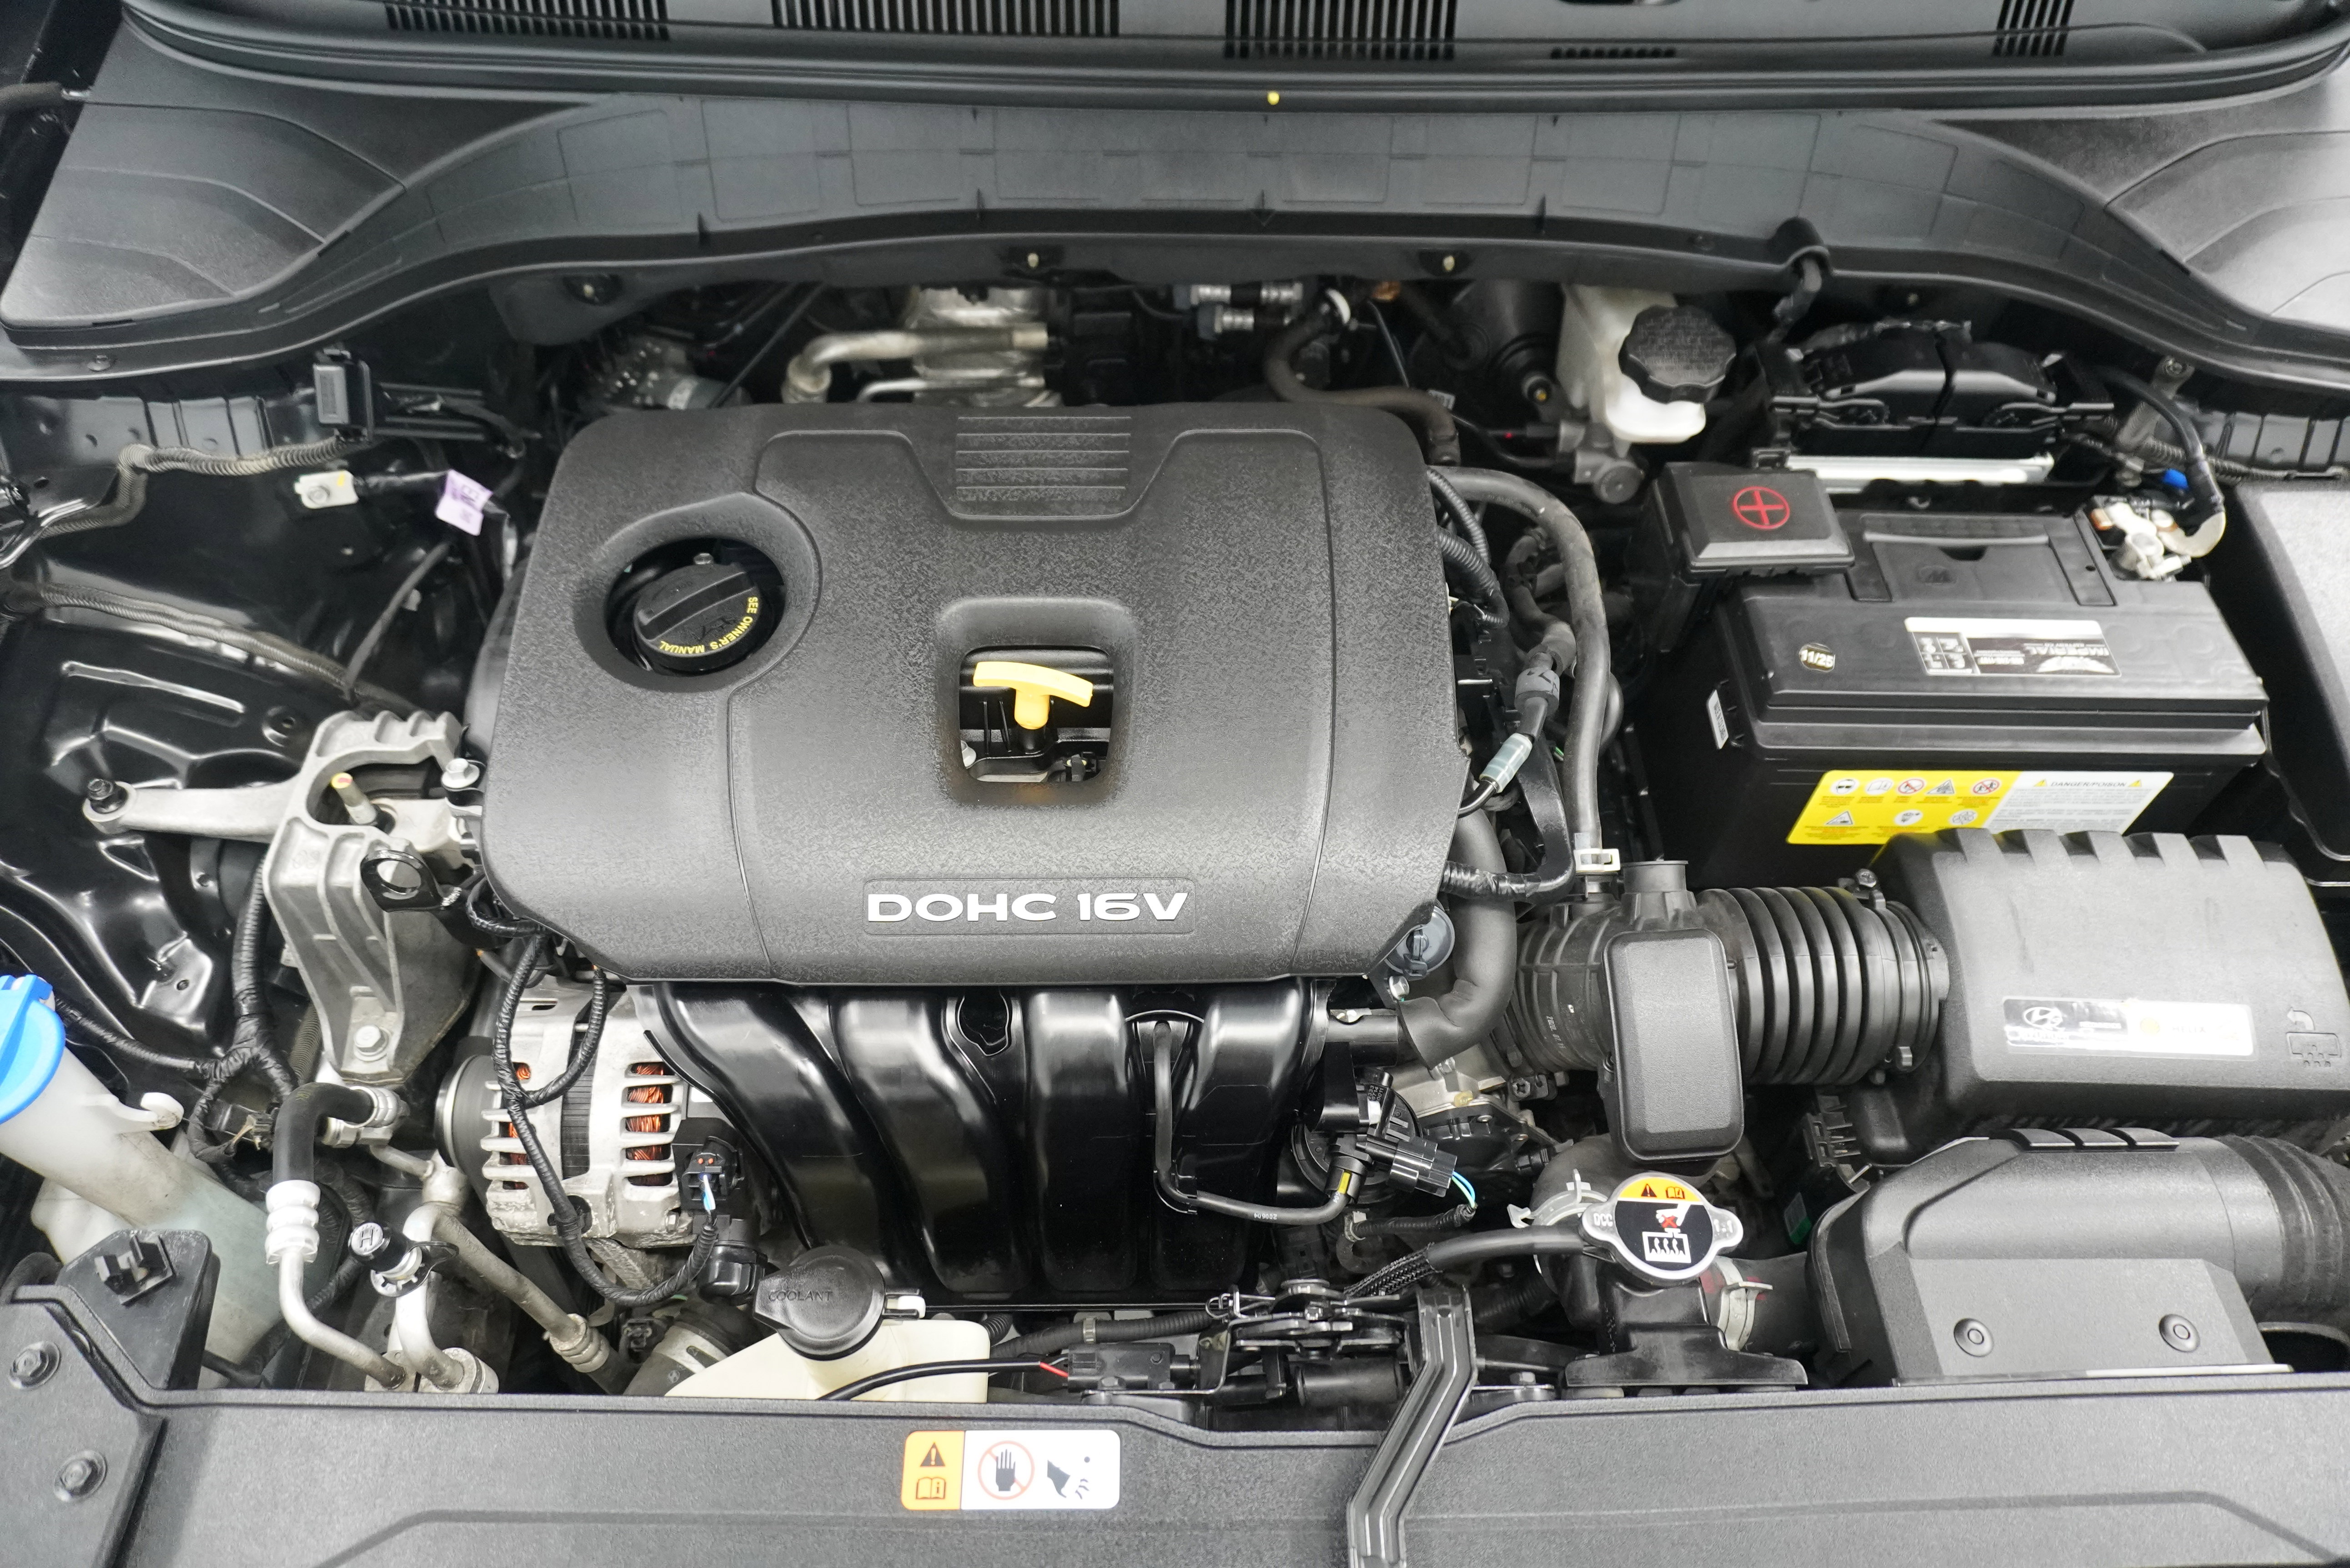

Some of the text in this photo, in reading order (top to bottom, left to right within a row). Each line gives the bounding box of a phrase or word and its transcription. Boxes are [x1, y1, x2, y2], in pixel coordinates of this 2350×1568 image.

[659, 596, 759, 654] SEE OWNER'S MANUAL
[1801, 649, 1833, 668] 11/25
[2025, 646, 2109, 656] IMPERIAL
[868, 892, 1188, 922] DOHC 16V
[1593, 1212, 1613, 1227] DCC
[360, 1228, 374, 1248] H
[768, 1290, 833, 1302] COOLANT
